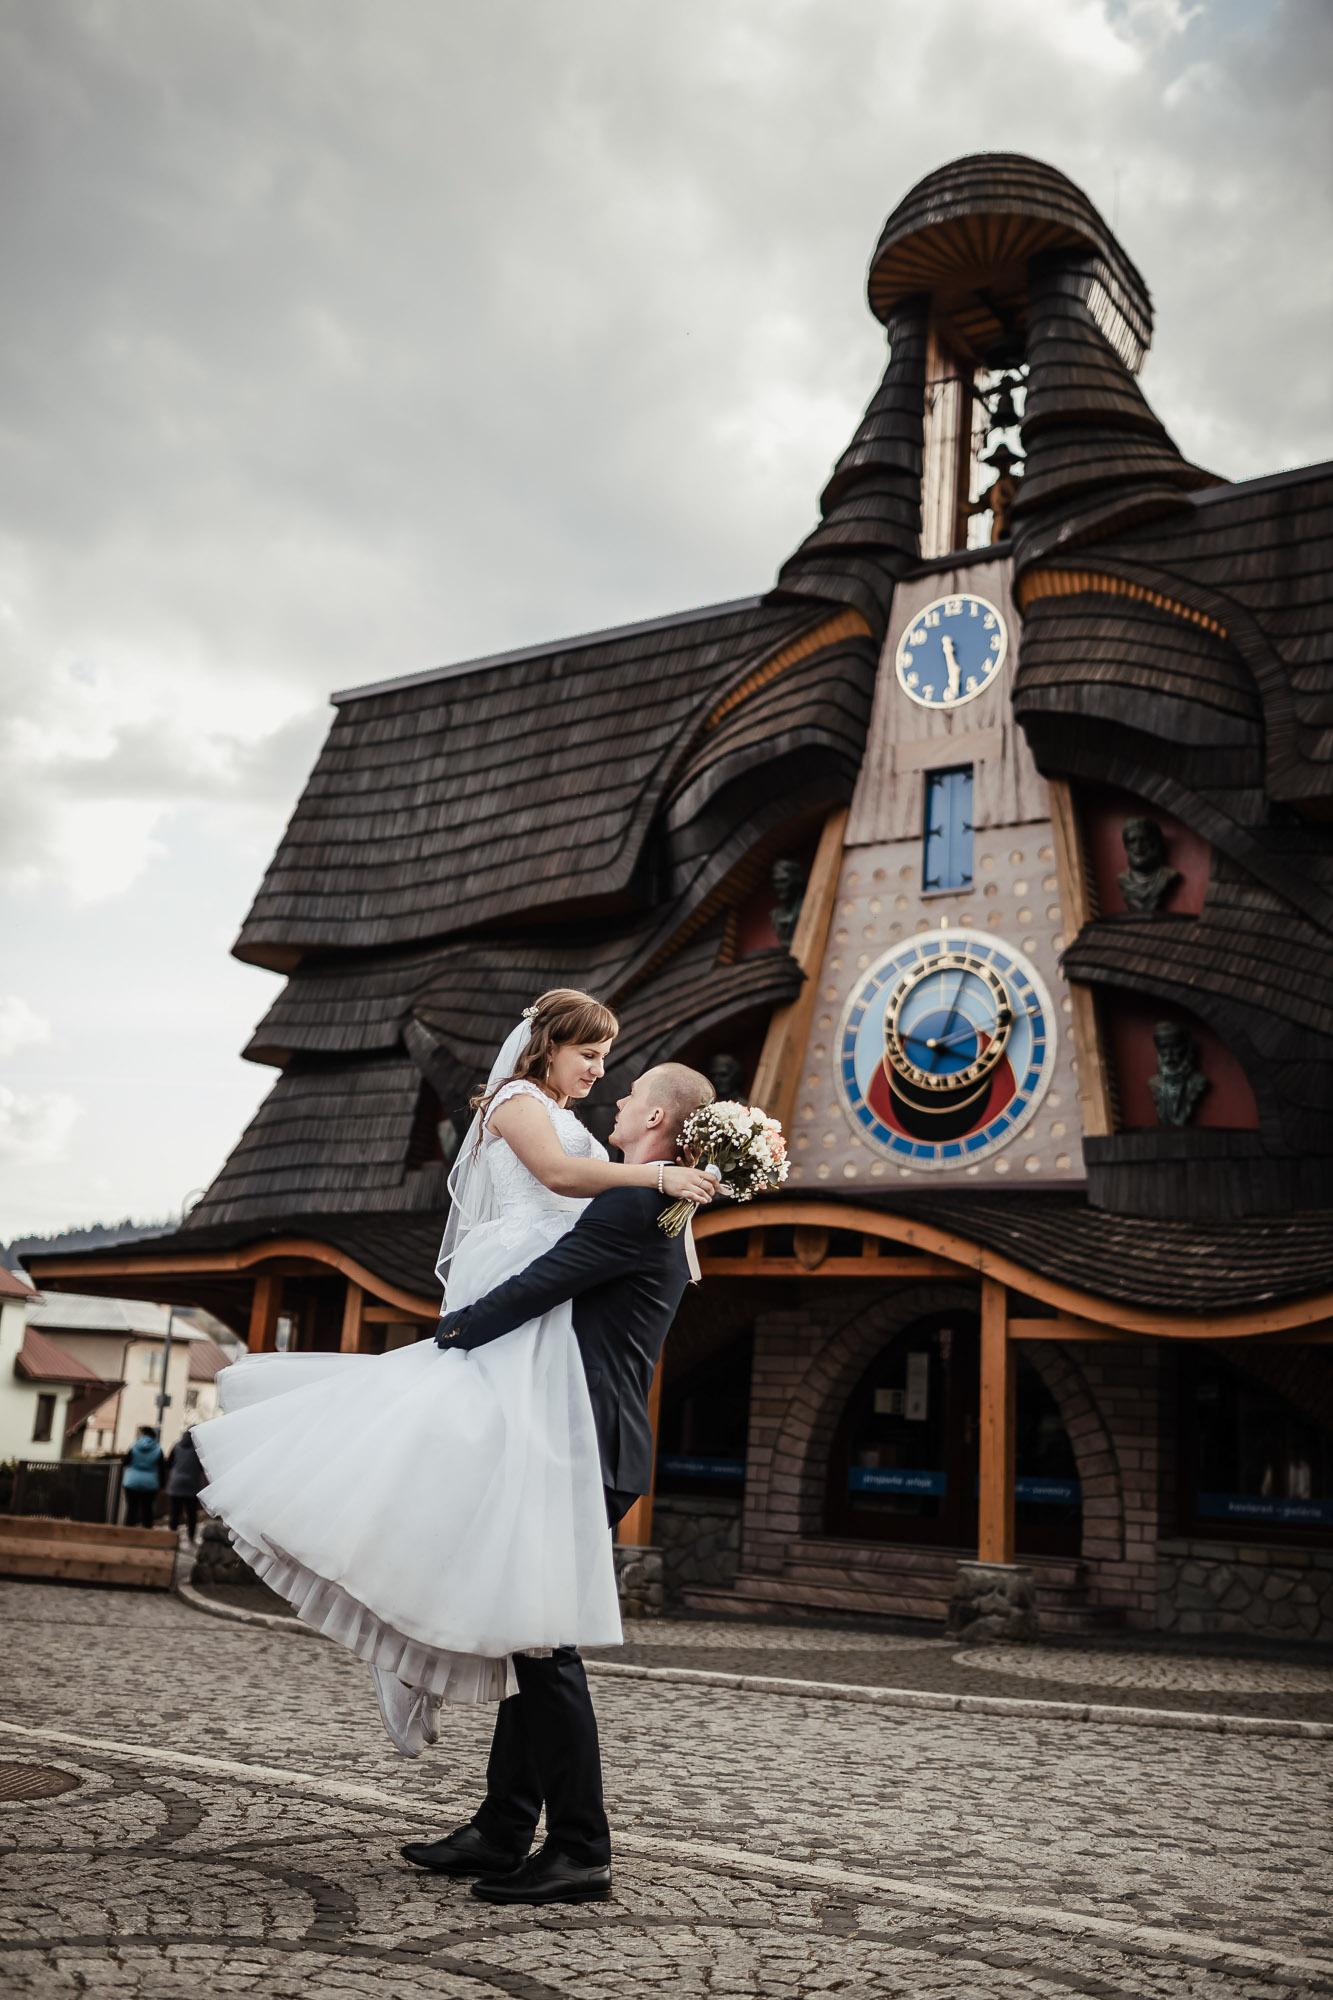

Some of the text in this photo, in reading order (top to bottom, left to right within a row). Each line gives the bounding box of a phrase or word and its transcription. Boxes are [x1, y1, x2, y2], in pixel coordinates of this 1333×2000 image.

[944, 600, 963, 617] 12
[969, 601, 979, 617] 1
[925, 610, 940, 628] 11
[983, 612, 996, 630] 2
[909, 628, 928, 647] 10
[989, 633, 1000, 651] 3
[922, 684, 934, 700] 7
